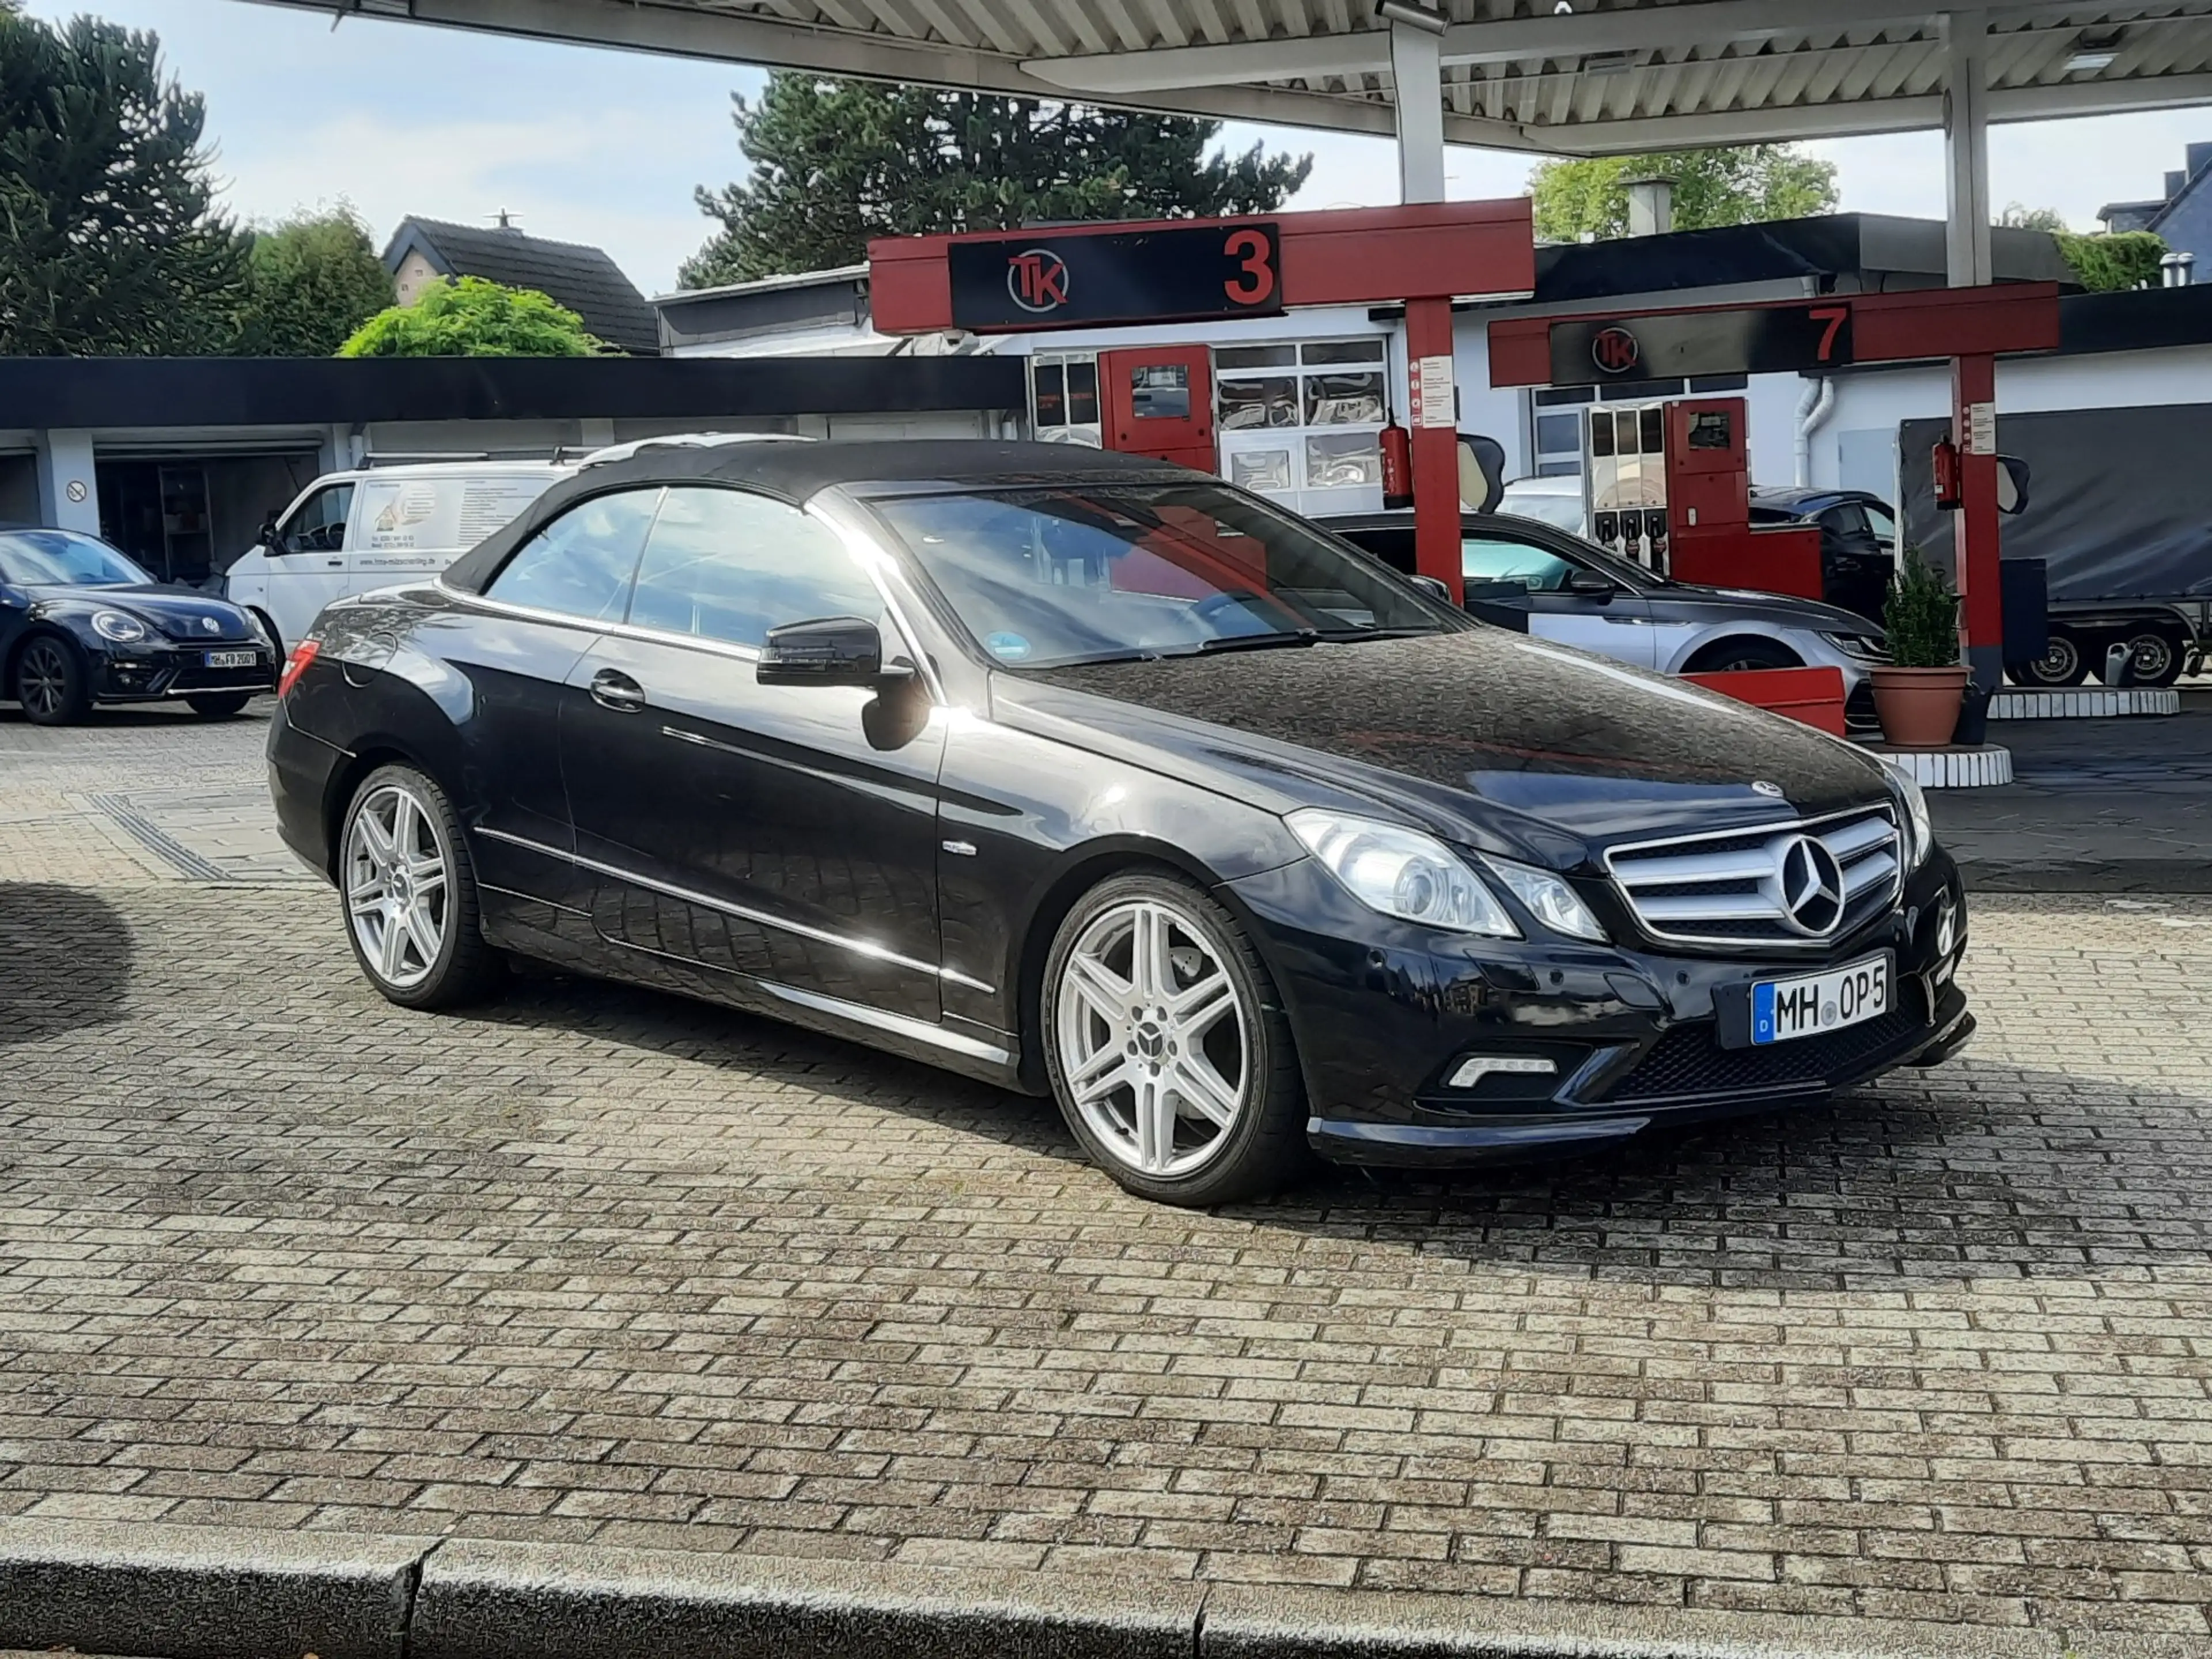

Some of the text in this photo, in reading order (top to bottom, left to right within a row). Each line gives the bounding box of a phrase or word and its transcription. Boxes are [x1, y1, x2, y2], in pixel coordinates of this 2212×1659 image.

[1007, 256, 1067, 305] TK
[1224, 229, 1274, 305] 3
[1809, 308, 1847, 361] 7
[1760, 1020, 1768, 1032] D
[1777, 984, 1819, 1033] MH
